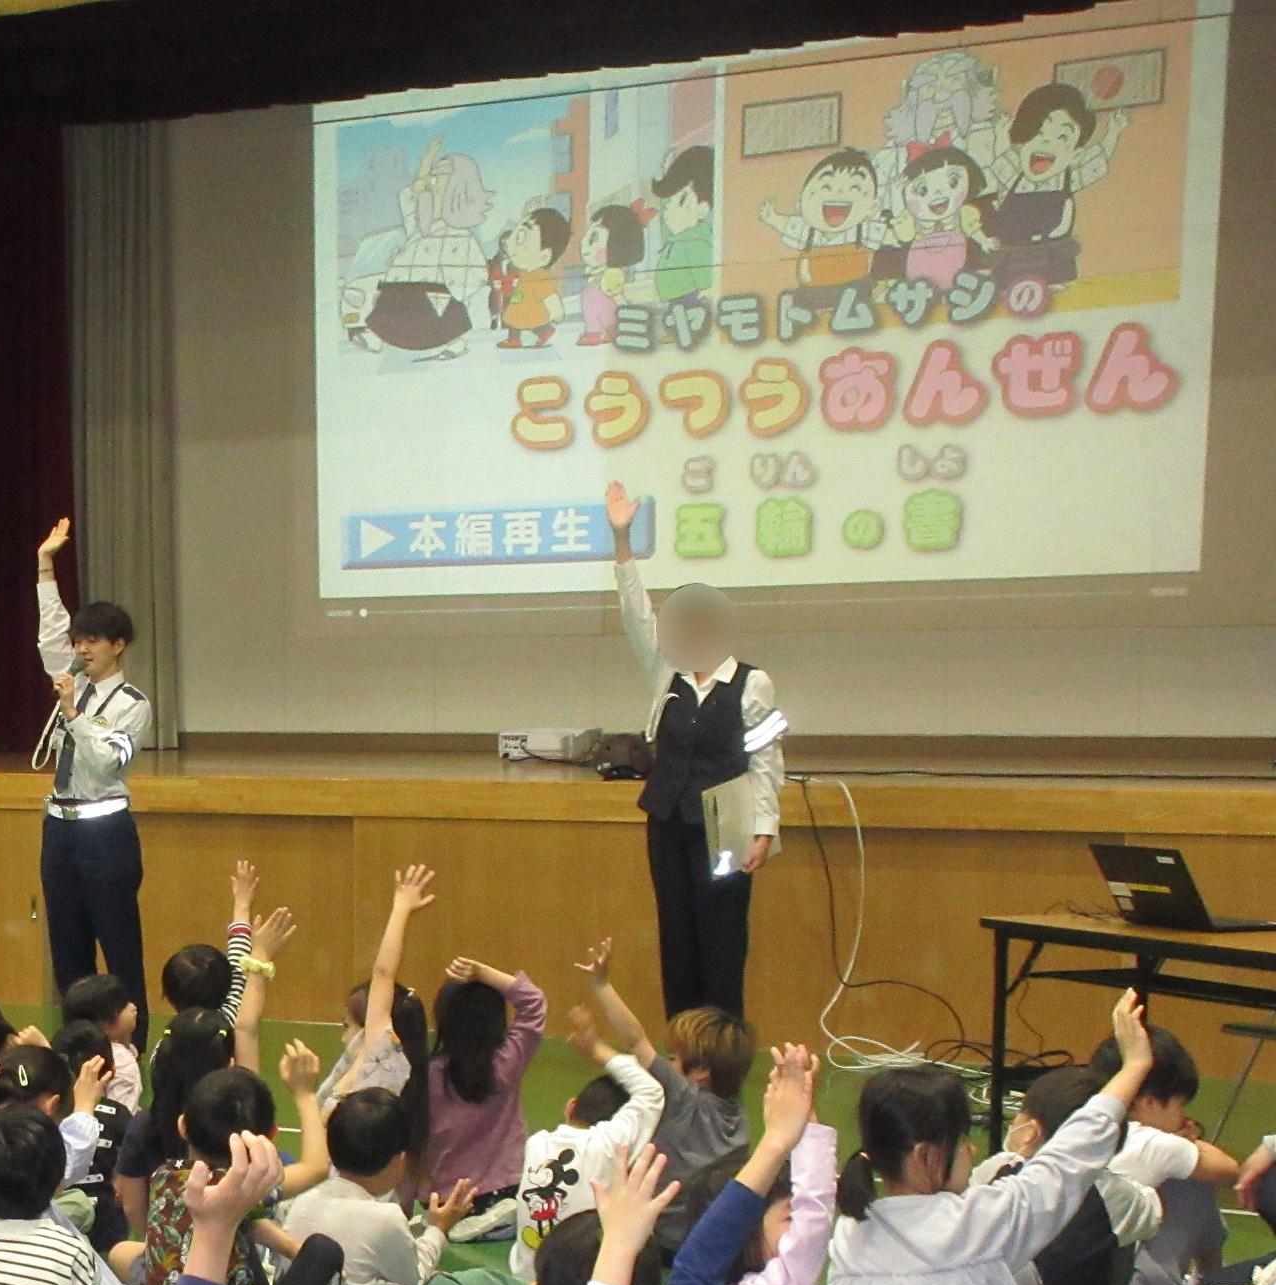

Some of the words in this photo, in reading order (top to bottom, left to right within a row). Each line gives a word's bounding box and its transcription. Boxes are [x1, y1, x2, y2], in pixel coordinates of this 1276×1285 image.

[613, 275, 1053, 354] ミヤモトムサシの
[511, 322, 1180, 450] こうつうあんぜん
[408, 508, 592, 556] 本編再生
